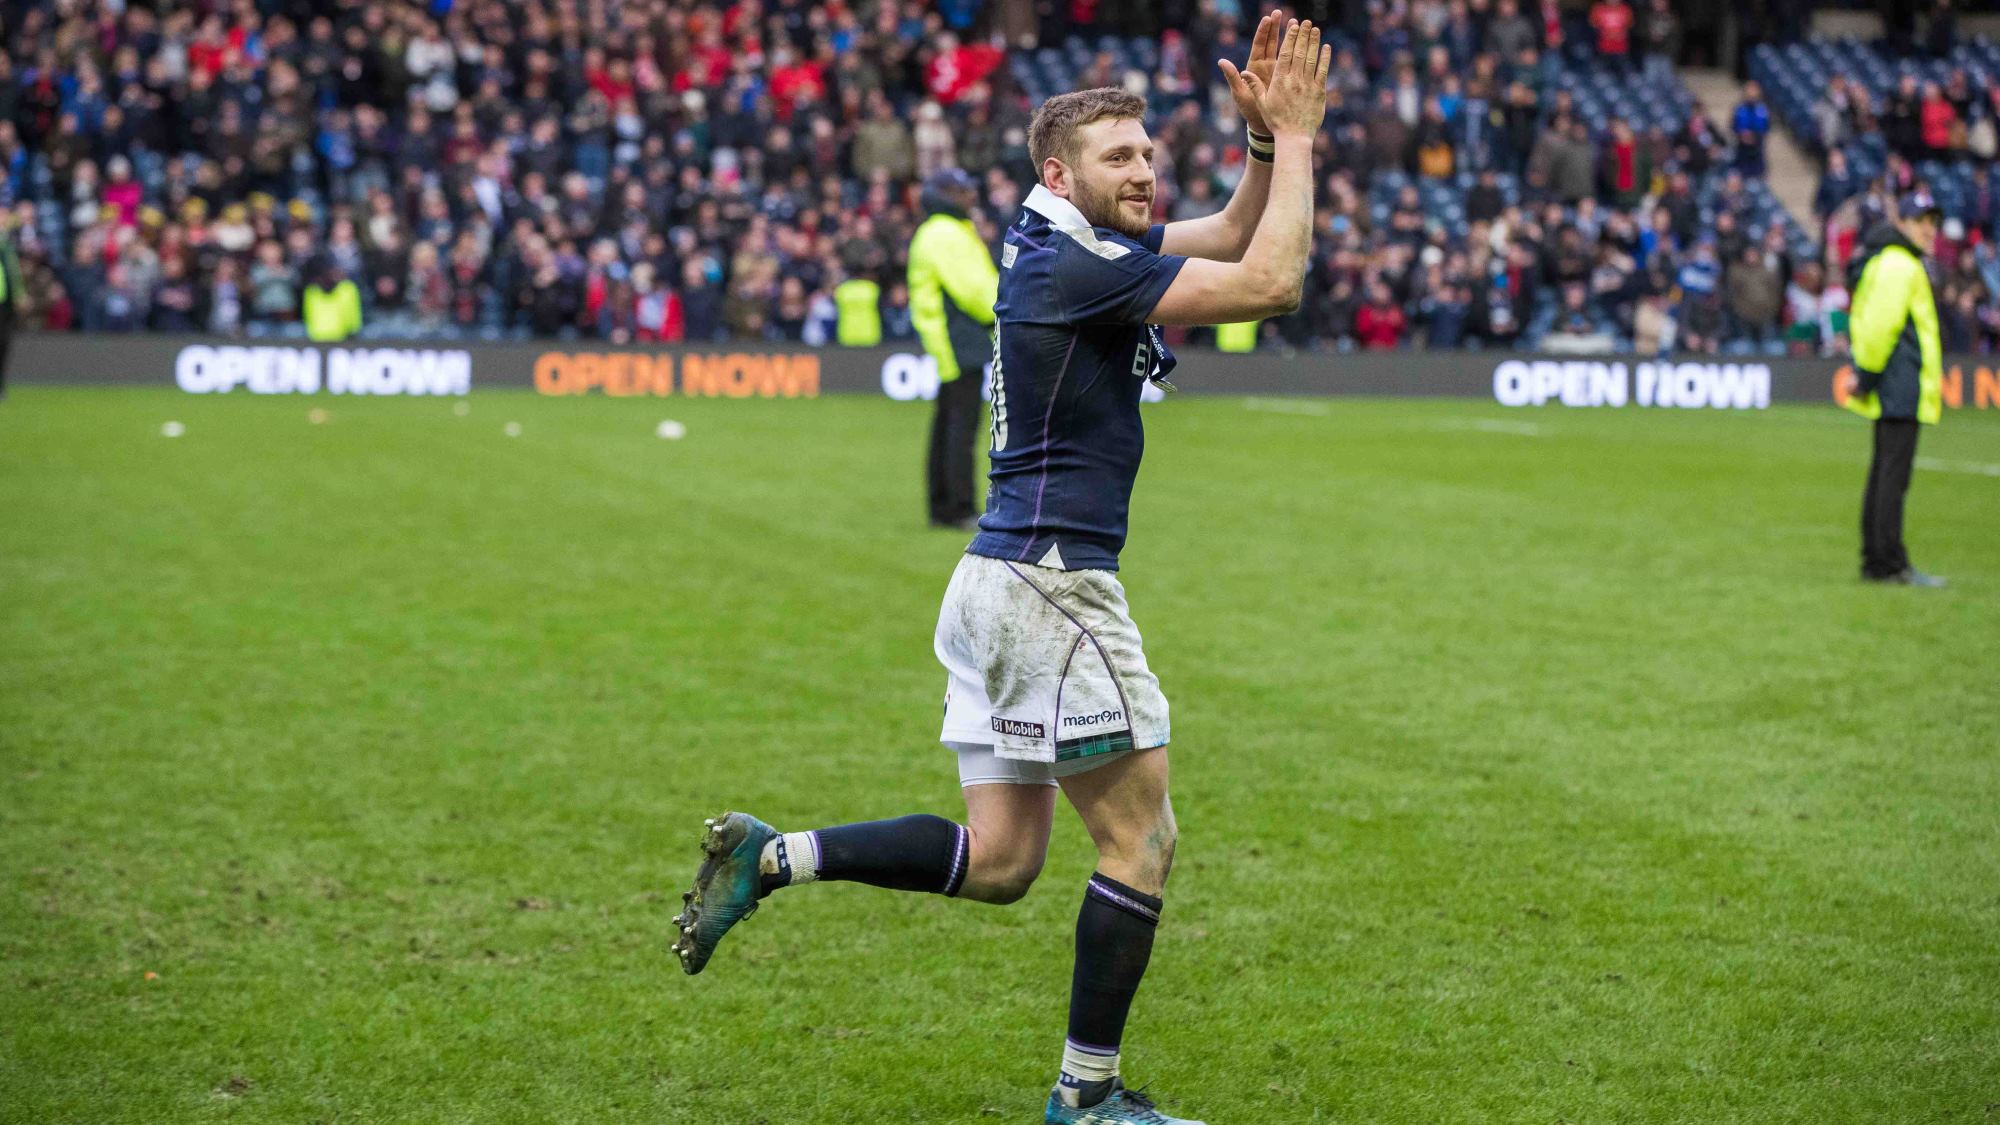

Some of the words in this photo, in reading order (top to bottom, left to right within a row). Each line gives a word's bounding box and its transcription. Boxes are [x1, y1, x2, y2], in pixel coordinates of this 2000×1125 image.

[175, 345, 322, 394] OPEN
[327, 347, 472, 395] NOW!
[533, 351, 674, 396] OPEN
[1493, 360, 1628, 407] OPEN
[1635, 362, 1771, 409] NOW!
[993, 717, 1003, 732] BT
[1004, 722, 1042, 737] Mobile
[1063, 710, 1122, 727] macron
